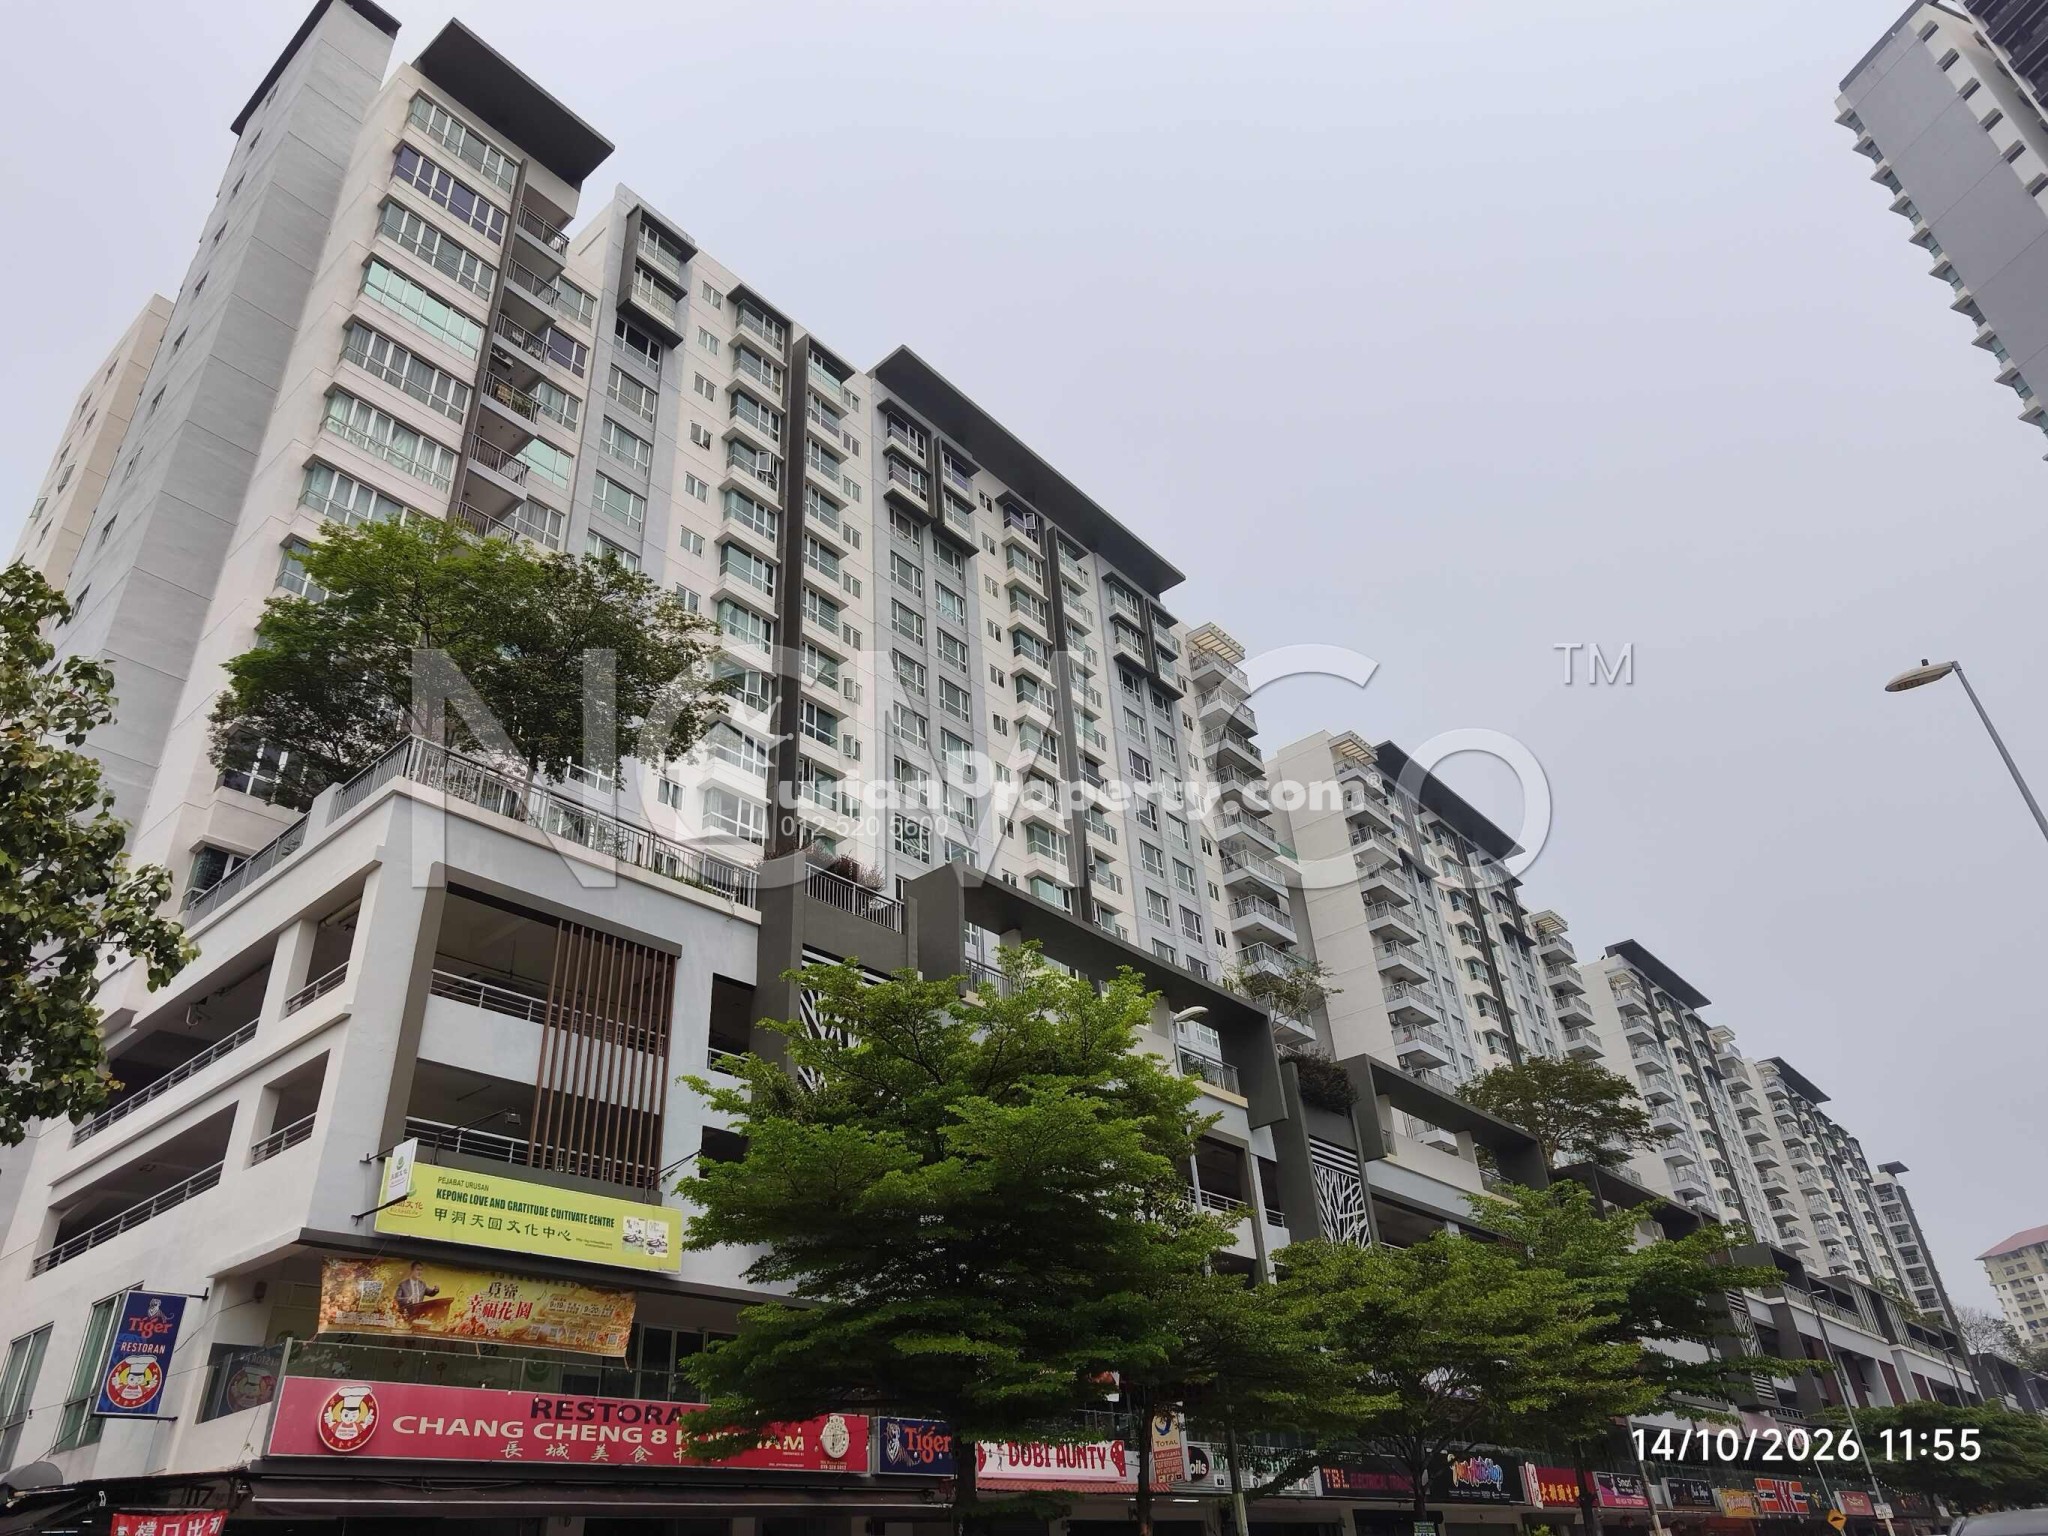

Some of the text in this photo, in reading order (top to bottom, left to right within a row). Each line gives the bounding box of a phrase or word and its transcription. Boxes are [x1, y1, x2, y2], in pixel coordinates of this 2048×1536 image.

[437, 1176, 490, 1192] PEJABAT URUSAN
[435, 1188, 469, 1203] KEPONG
[469, 1193, 489, 1207] LOVE
[489, 1197, 506, 1210] AND
[507, 1200, 549, 1217] GRATITUDE
[588, 1214, 615, 1228] CENTRE
[129, 1317, 173, 1338] Tiger
[120, 1342, 166, 1354] RESTORAN
[530, 1397, 697, 1427] RESTORA
[392, 1415, 525, 1439] CHANG
[532, 1421, 643, 1444] CHENG
[650, 1425, 669, 1445] 8
[500, 1440, 722, 1465] 長城美食中
[904, 1425, 952, 1464] Tiger
[1007, 1440, 1107, 1470] DOBI AUNTY
[1322, 1467, 1350, 1488] TBL
